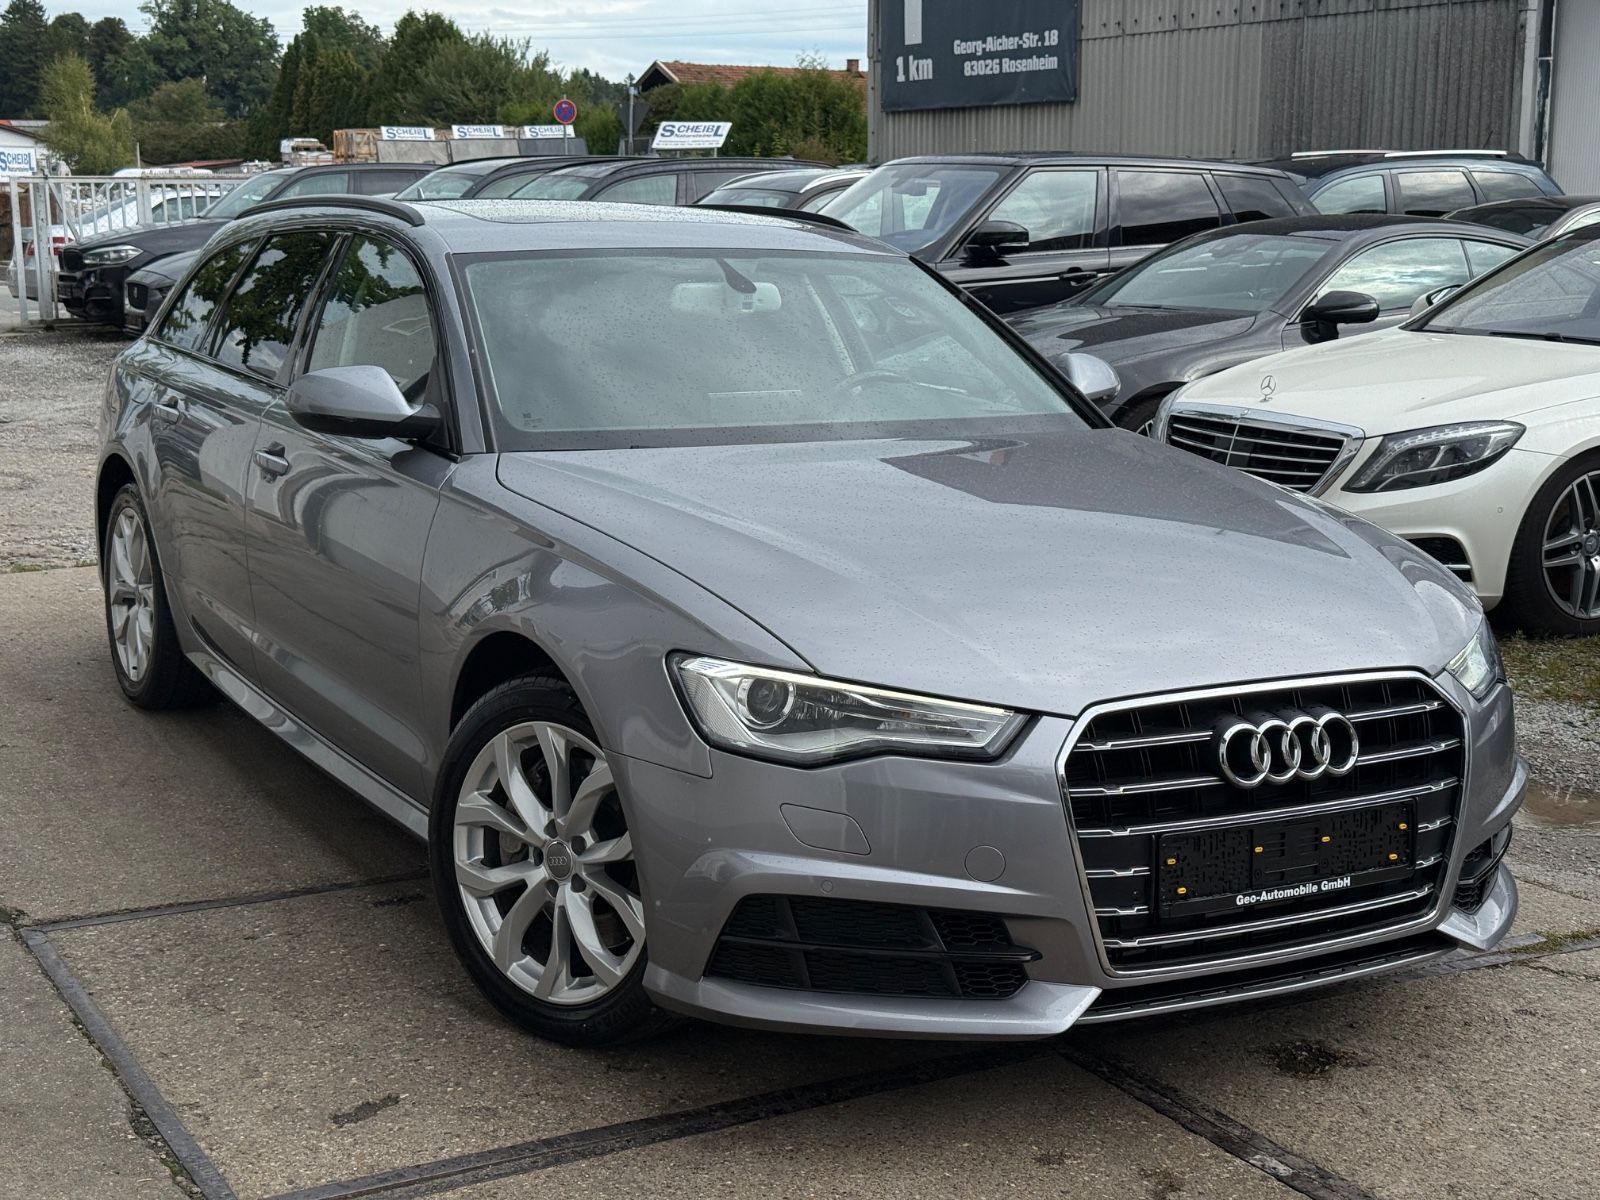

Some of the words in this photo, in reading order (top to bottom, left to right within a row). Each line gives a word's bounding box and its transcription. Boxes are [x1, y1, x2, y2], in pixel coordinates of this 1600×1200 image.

[953, 31, 1042, 56] Georg-Aicher-Str.
[1043, 29, 1059, 47] 18
[896, 56, 906, 83] 1
[909, 55, 933, 81] km
[963, 59, 1000, 77] 83026
[1001, 54, 1058, 74] Rosenheim
[386, 127, 432, 140] SCHEIBL
[457, 126, 501, 138] SCHEIBL
[660, 124, 724, 138] SCHEIBL
[0, 151, 35, 172] SCHEIBL
[1236, 882, 1318, 906] Geo-Automobile
[1321, 877, 1351, 892] GmbH
